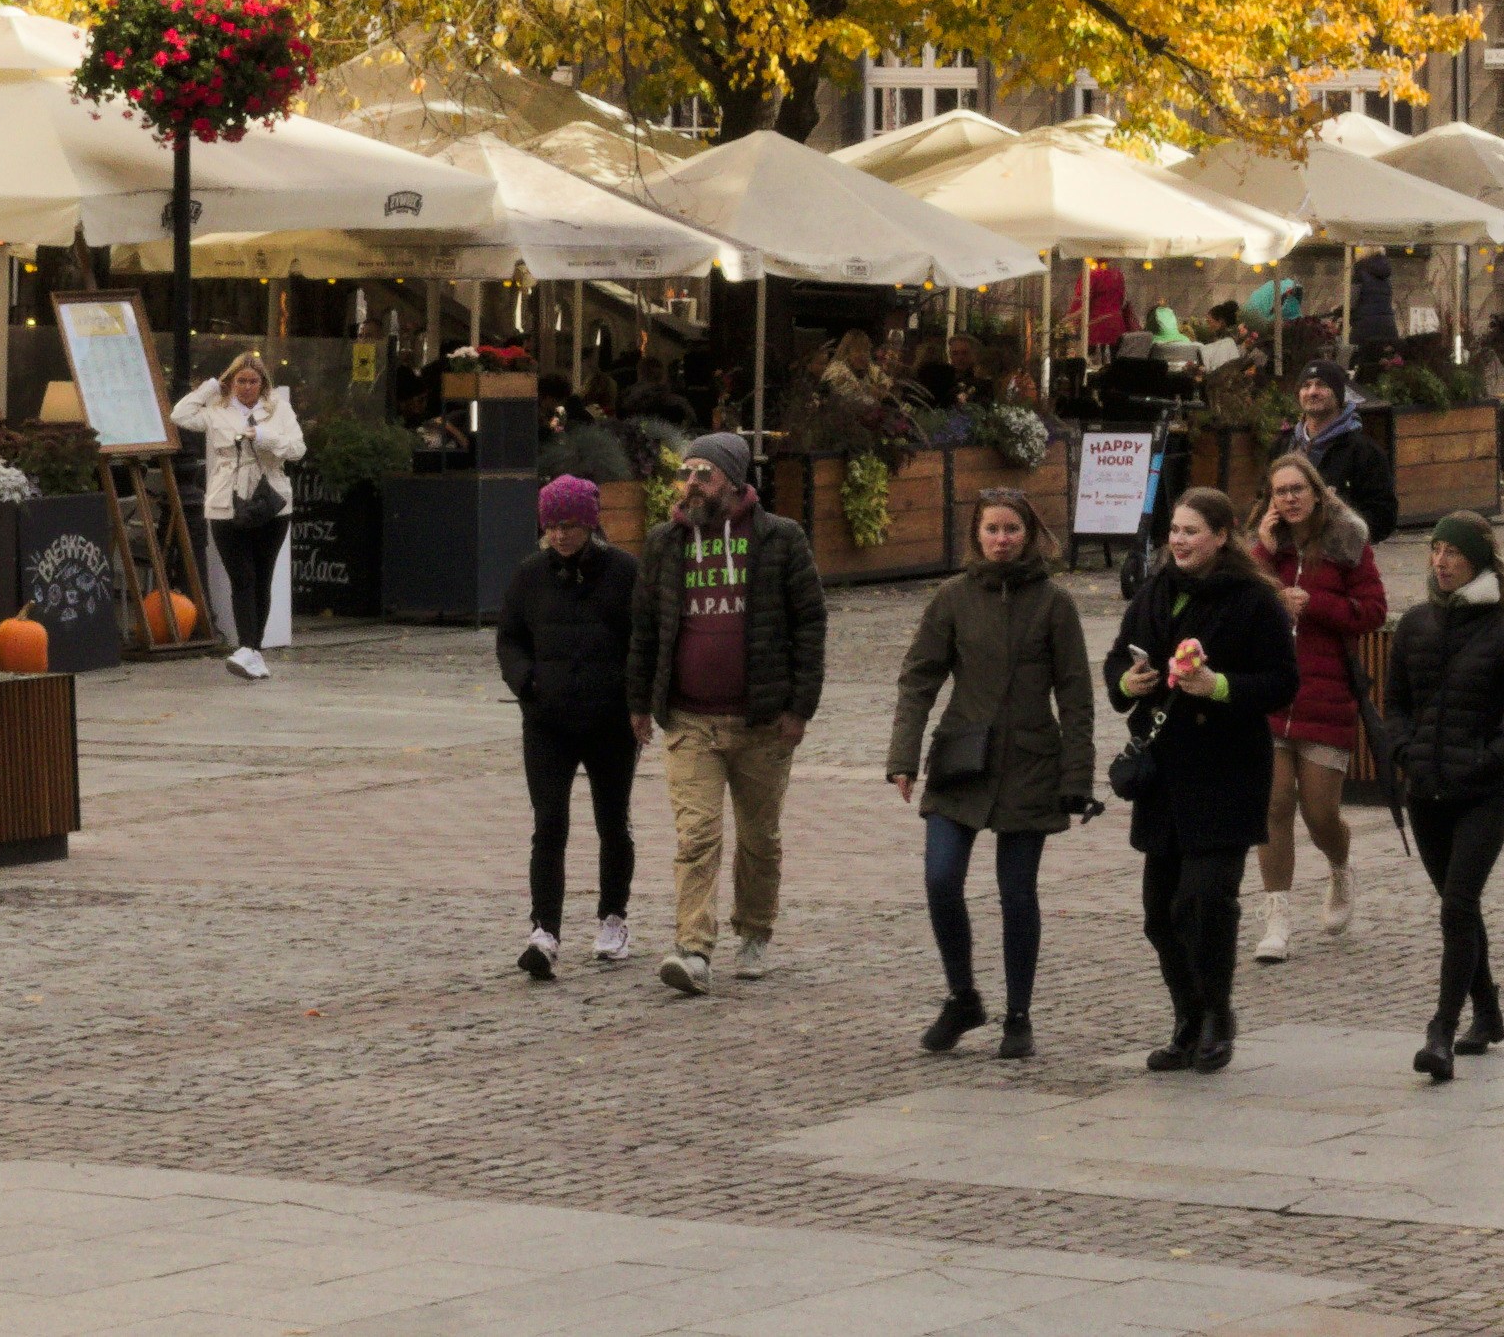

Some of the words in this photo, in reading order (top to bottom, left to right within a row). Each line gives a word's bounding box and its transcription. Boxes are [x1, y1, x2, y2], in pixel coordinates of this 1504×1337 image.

[1089, 439, 1143, 455] HAPPY
[1097, 455, 1134, 466] HOUR
[293, 520, 338, 542] orsz
[38, 533, 110, 583] BREAKFAST
[293, 548, 350, 584] ndacz
